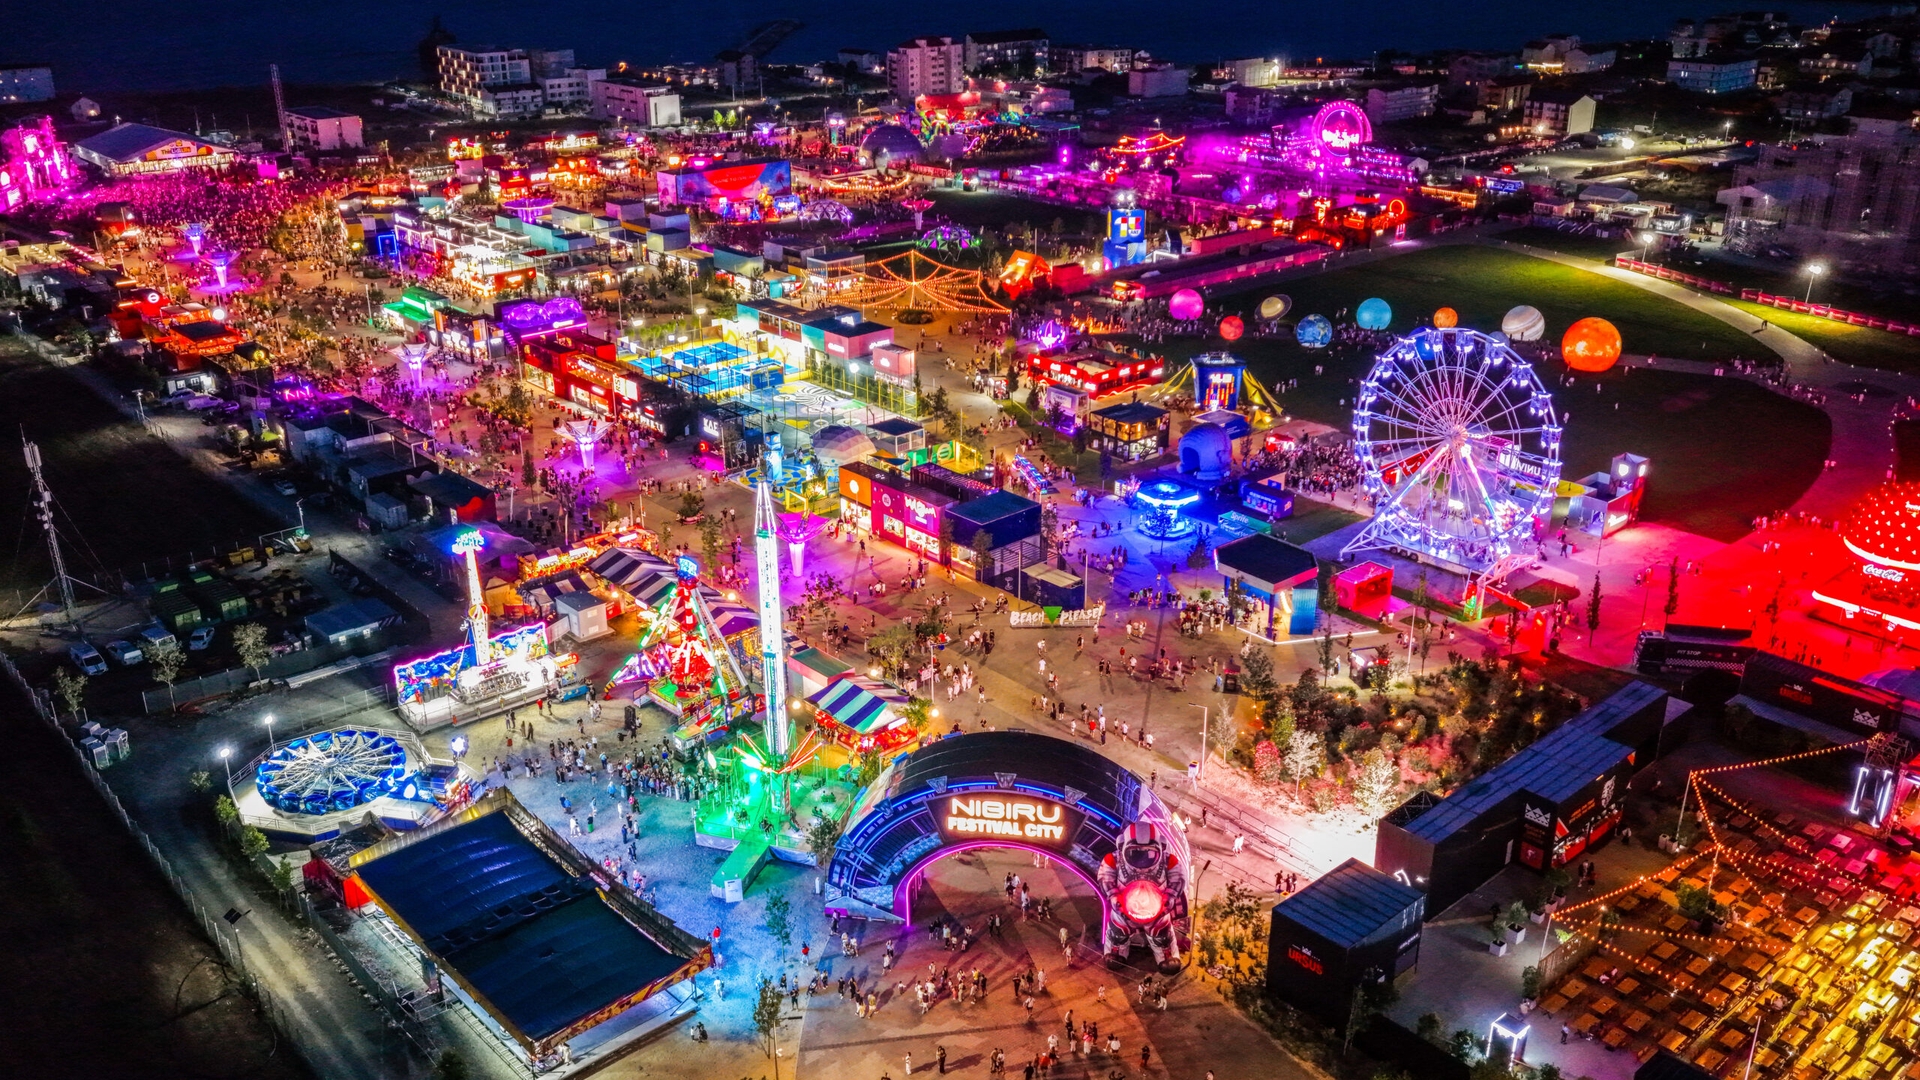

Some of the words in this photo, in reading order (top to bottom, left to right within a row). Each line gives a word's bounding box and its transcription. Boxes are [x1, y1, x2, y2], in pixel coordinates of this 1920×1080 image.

[1230, 511, 1249, 524] Sprite
[1009, 610, 1045, 626] BEACH
[951, 798, 1061, 823] NIBIRU
[947, 816, 1023, 836] FESTIVAL
[1024, 823, 1064, 839] CITY
[1288, 947, 1323, 975] URSUS
